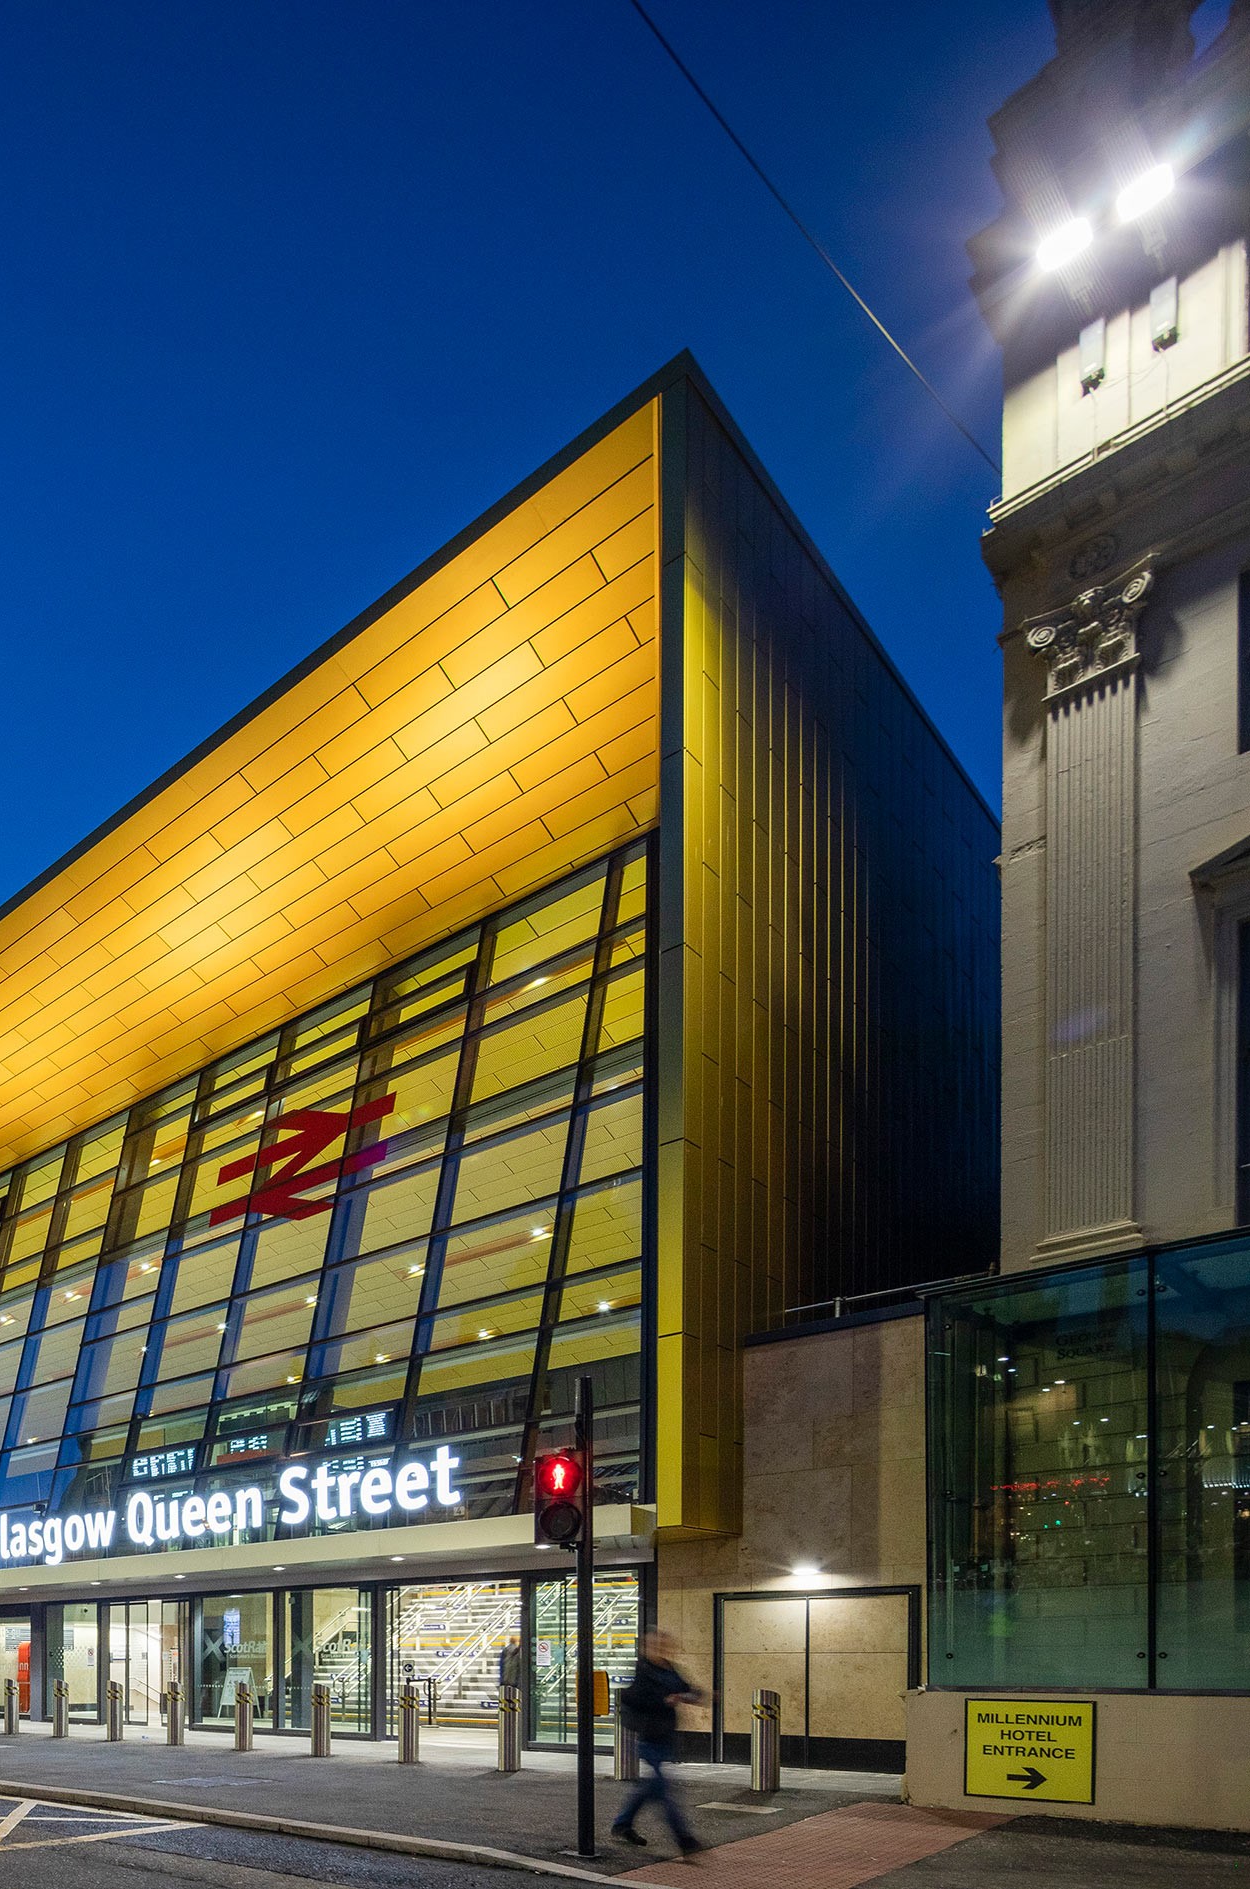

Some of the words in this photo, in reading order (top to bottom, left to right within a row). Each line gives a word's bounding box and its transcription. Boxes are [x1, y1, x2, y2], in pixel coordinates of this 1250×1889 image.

[1057, 1342, 1115, 1359] SQUARE
[127, 1487, 262, 1546] Queen
[279, 1445, 461, 1524] Street
[977, 1713, 1082, 1726] MILLENNIUM
[1000, 1729, 1057, 1742] HOTEL
[982, 1745, 1075, 1759] ENTRANCE
